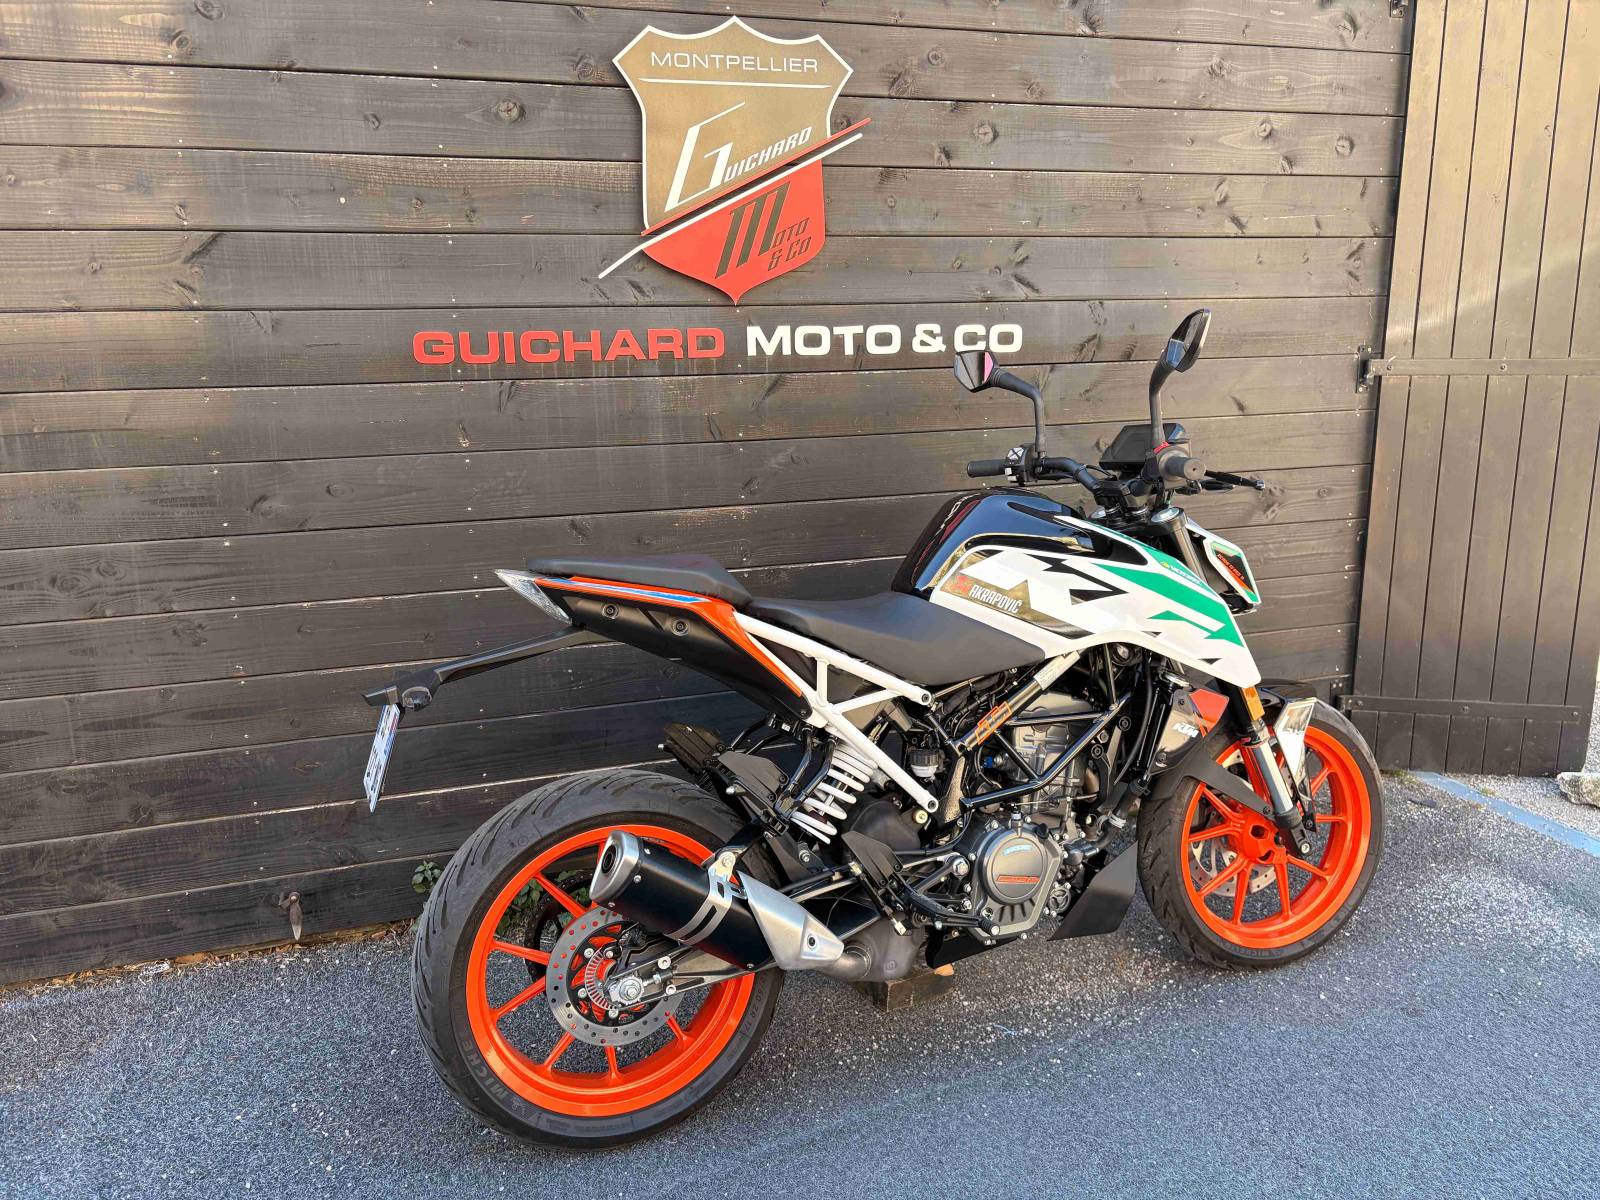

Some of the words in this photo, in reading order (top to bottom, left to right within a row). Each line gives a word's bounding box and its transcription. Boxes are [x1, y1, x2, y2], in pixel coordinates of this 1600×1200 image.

[651, 52, 818, 73] MONTPELLIER
[664, 101, 812, 213] GUICHARD
[714, 181, 809, 279] MOTO
[767, 249, 782, 272] &
[787, 237, 812, 264] CO
[412, 328, 726, 365] GUICHARD
[746, 325, 901, 357] MOTO
[912, 325, 946, 354] &
[953, 323, 1023, 354] CO
[1172, 722, 1199, 738] KTM
